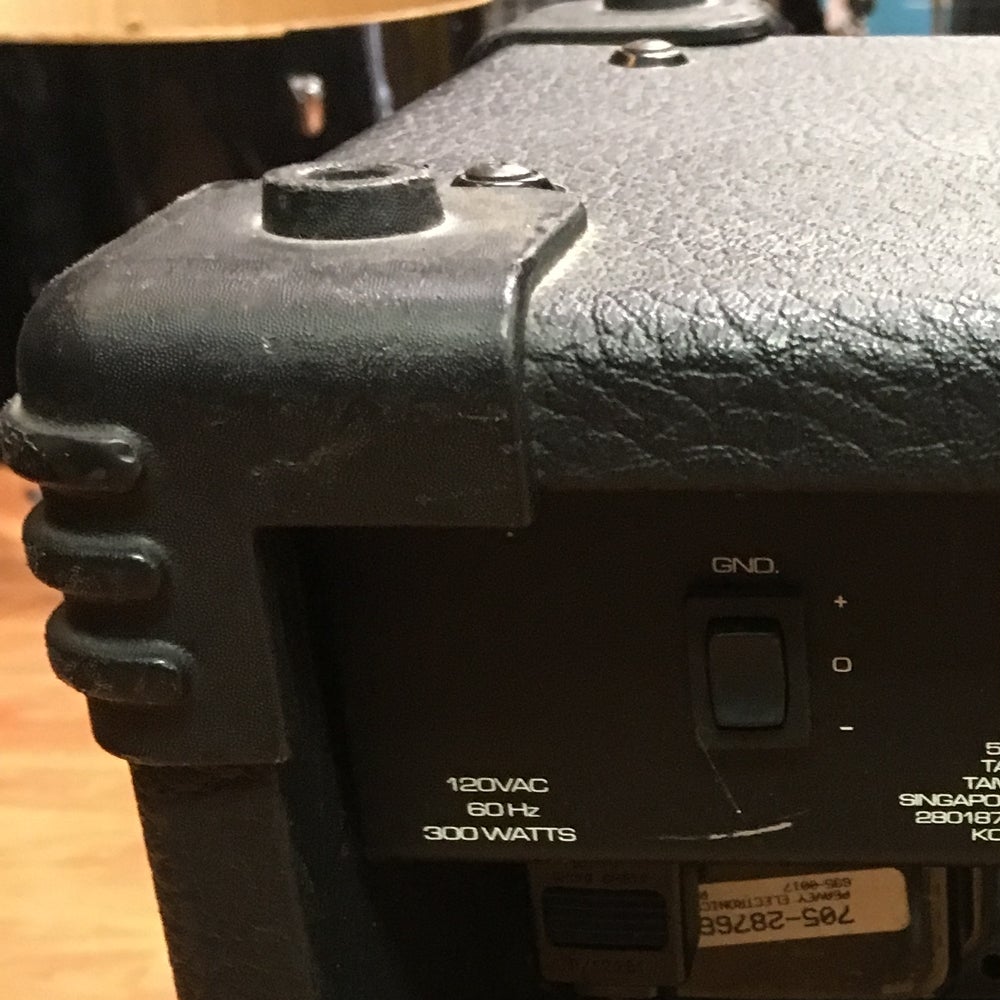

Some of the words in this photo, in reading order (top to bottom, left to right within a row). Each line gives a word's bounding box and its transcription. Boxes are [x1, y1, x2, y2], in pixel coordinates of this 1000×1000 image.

[711, 557, 780, 574] GND.
[446, 776, 550, 793] 120VAC
[465, 801, 504, 817] 60
[507, 802, 542, 818] Hz
[422, 825, 479, 841] 300
[481, 826, 578, 842] WATTS
